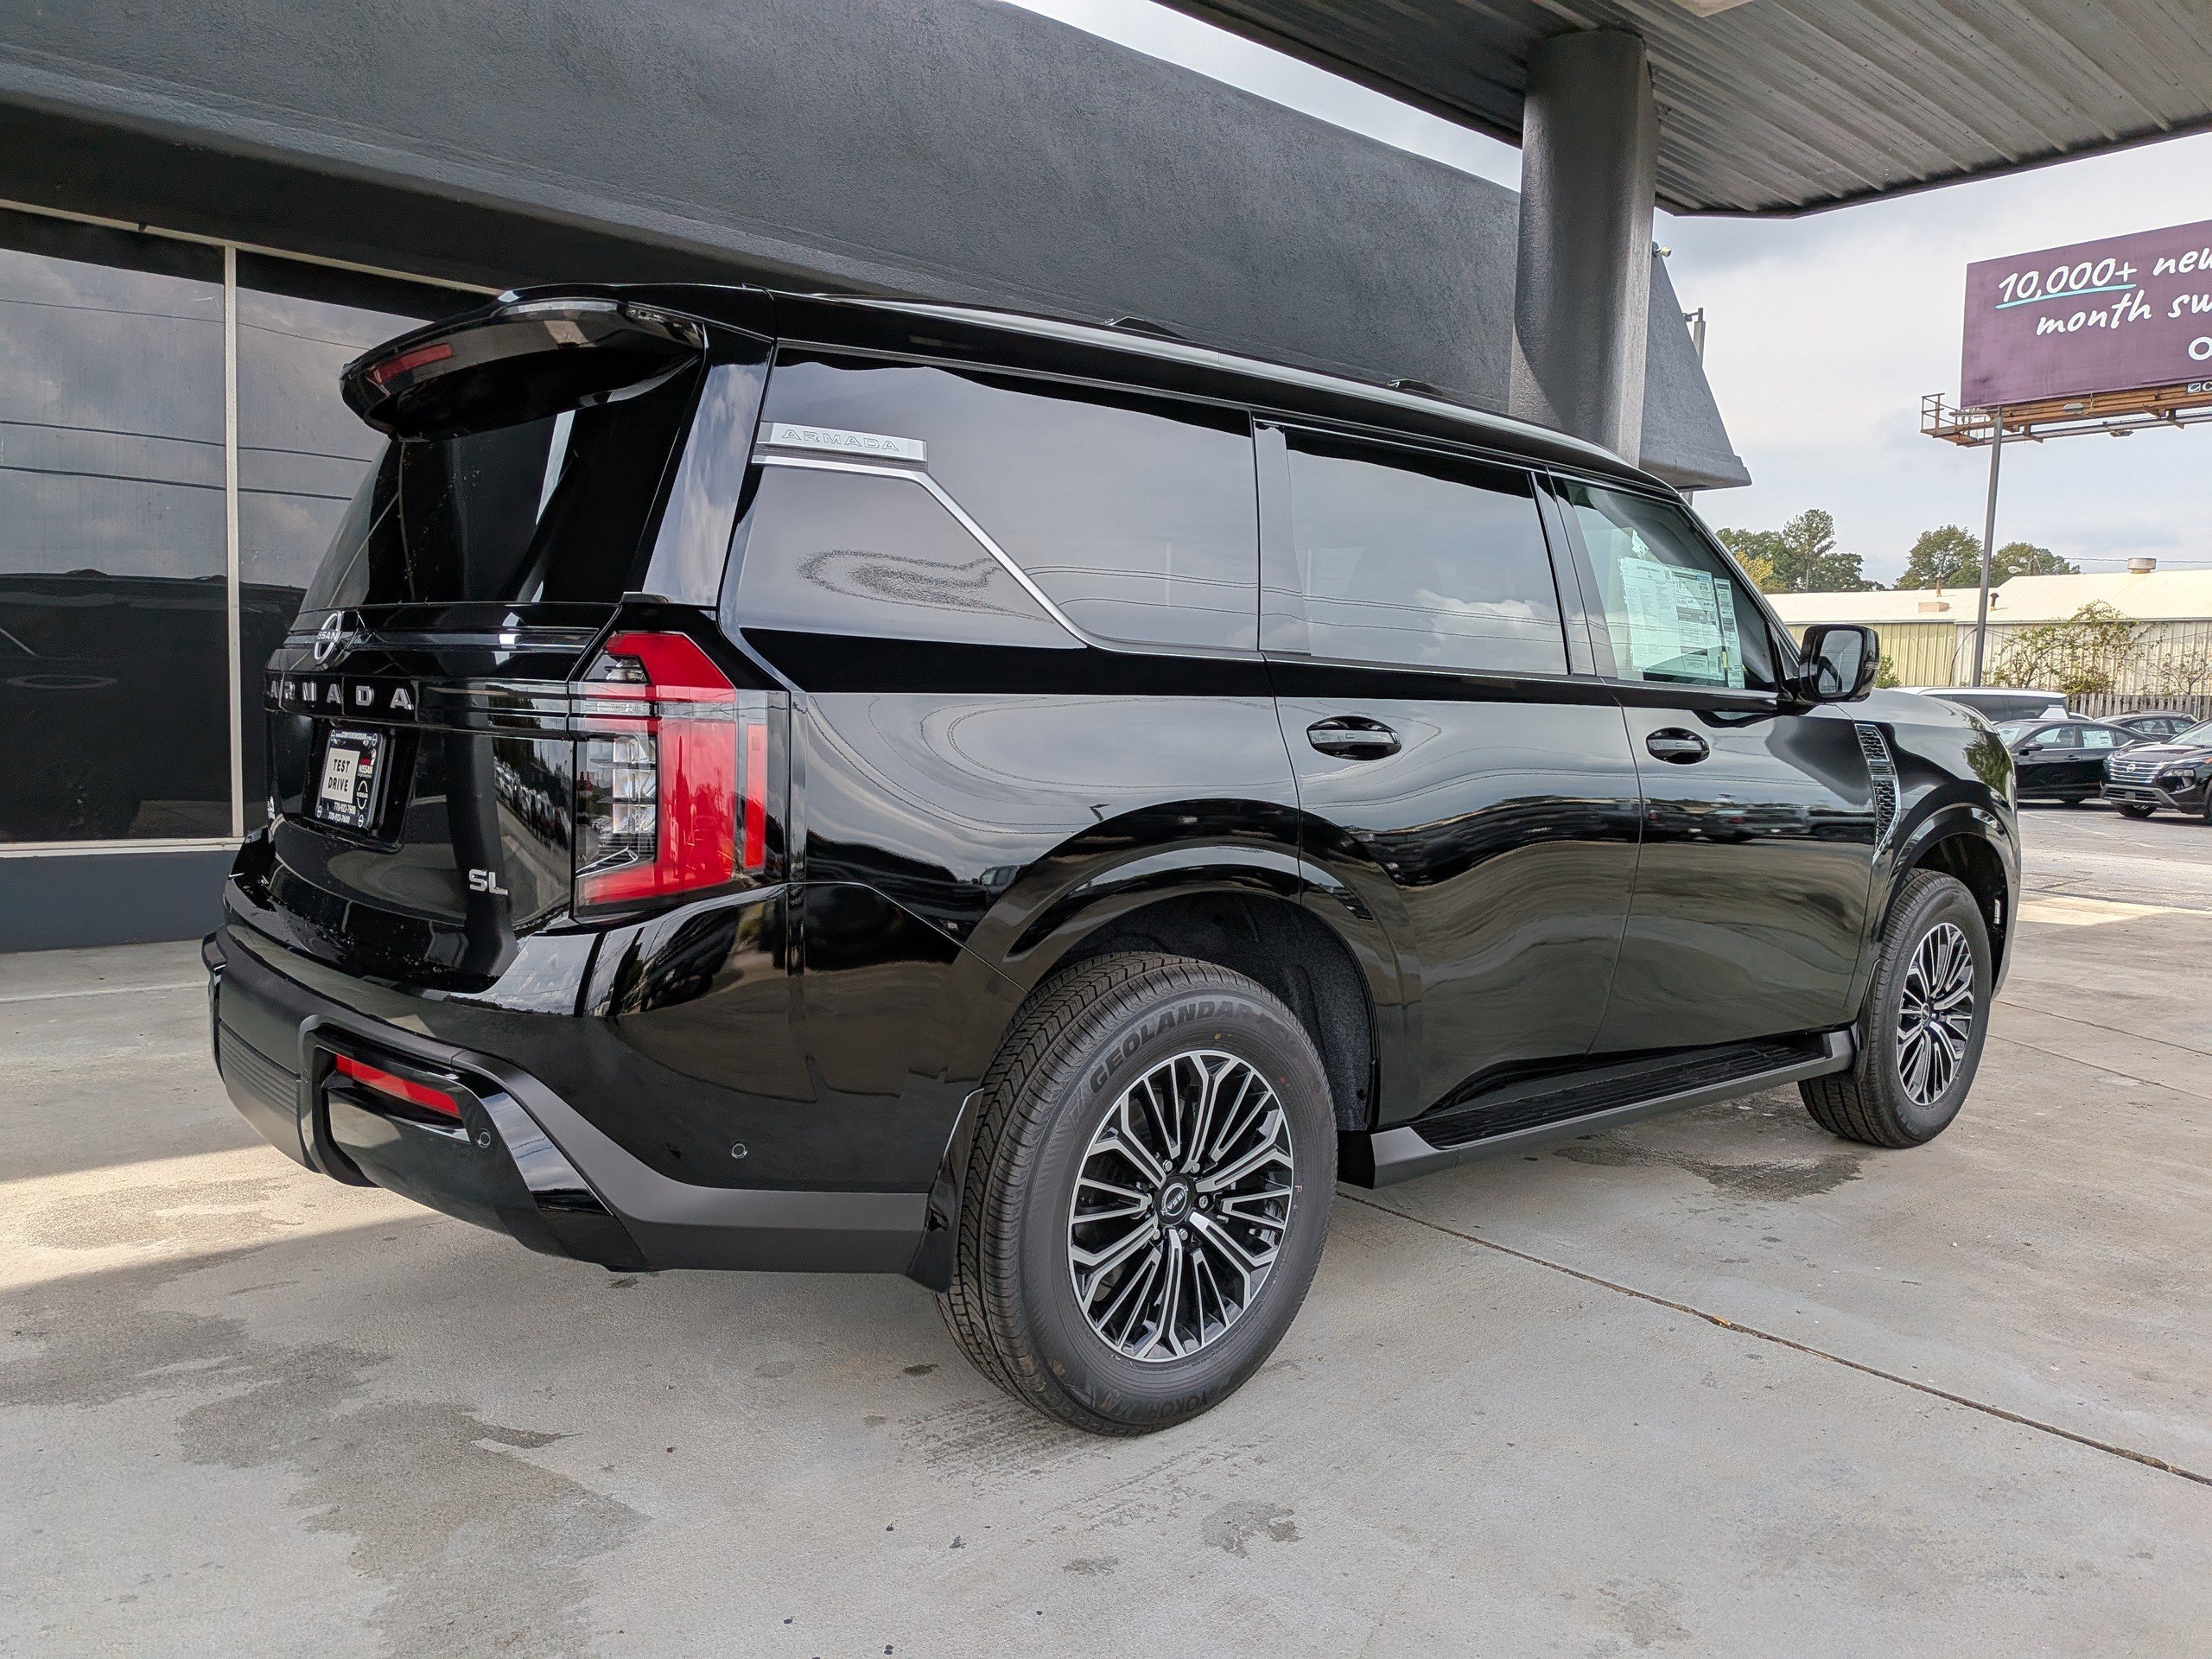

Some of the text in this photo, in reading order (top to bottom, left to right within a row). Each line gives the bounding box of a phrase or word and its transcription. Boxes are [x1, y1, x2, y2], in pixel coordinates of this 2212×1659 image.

[1999, 257, 2138, 302] 10,000+
[2036, 289, 2152, 335] month
[782, 429, 899, 451] ARMADA
[267, 680, 413, 710] ARMADA
[334, 759, 350, 773] TEST
[327, 776, 348, 792] DRIVE
[469, 868, 508, 895] SL
[1160, 1184, 1189, 1217] NISSAN
